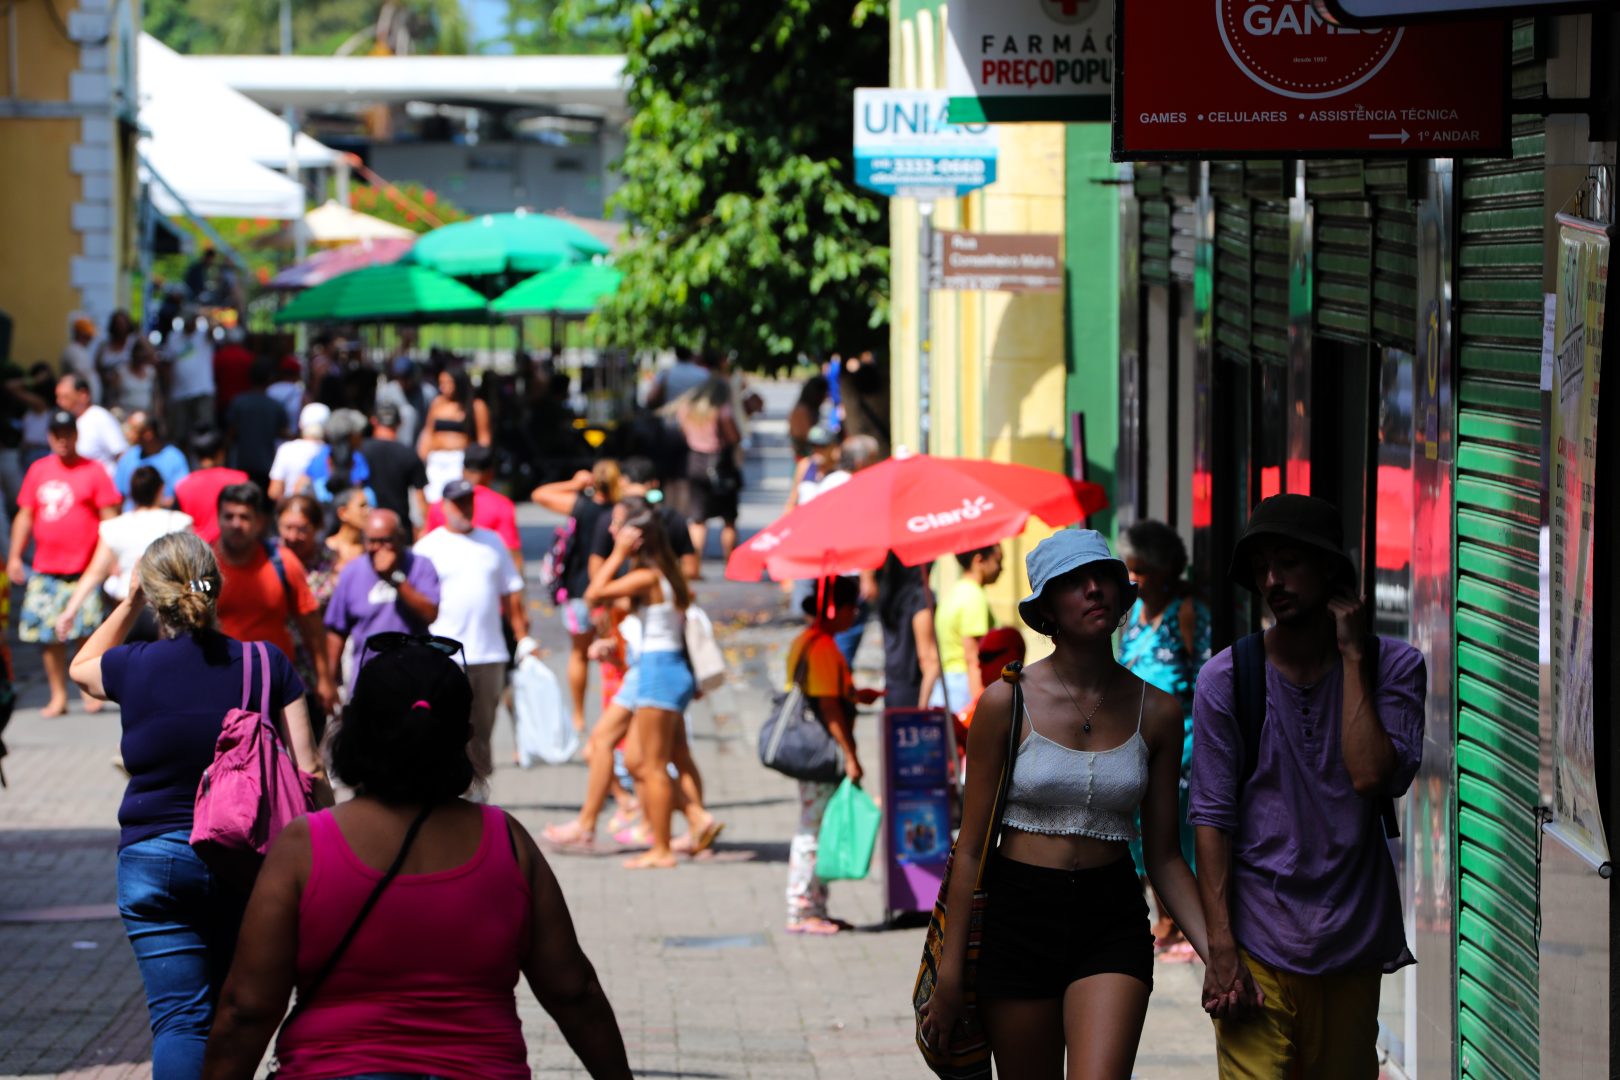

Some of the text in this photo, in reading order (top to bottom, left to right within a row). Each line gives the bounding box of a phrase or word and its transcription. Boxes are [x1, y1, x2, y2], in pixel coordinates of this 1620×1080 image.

[1243, 5, 1384, 36] GAM
[1139, 106, 1459, 124] GAMES CELULARES ASSISTÊNCIA TÉCNICA
[1432, 130, 1480, 142] ANDAR
[906, 497, 987, 533] Claro
